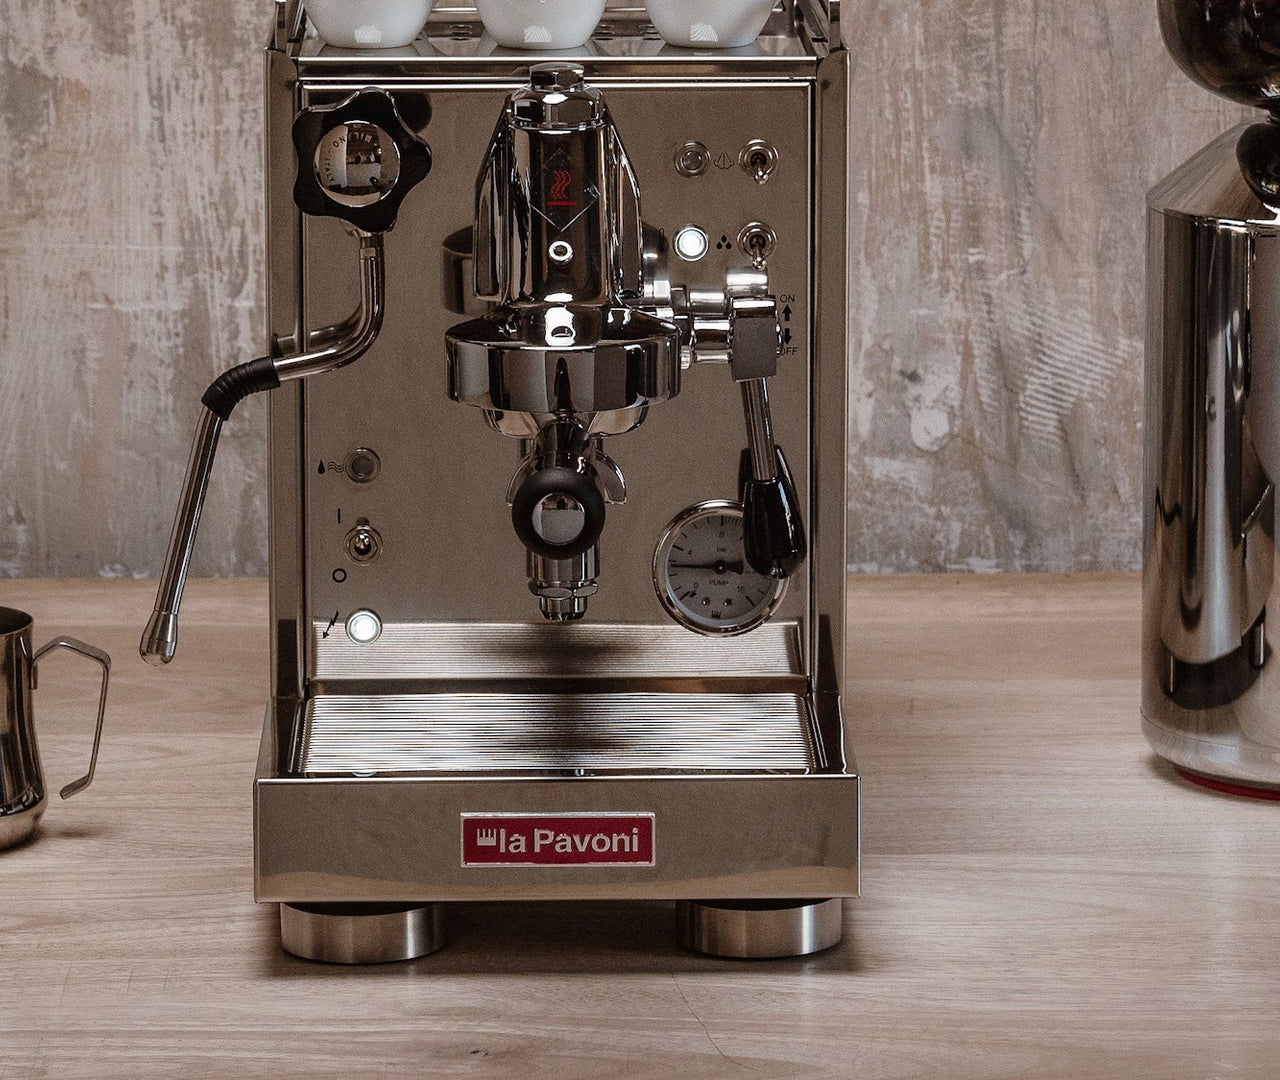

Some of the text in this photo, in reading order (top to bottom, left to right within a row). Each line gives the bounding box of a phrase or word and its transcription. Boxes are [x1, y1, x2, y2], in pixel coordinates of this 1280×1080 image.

[780, 294, 795, 303] ON
[499, 827, 639, 853] la Pavoni
